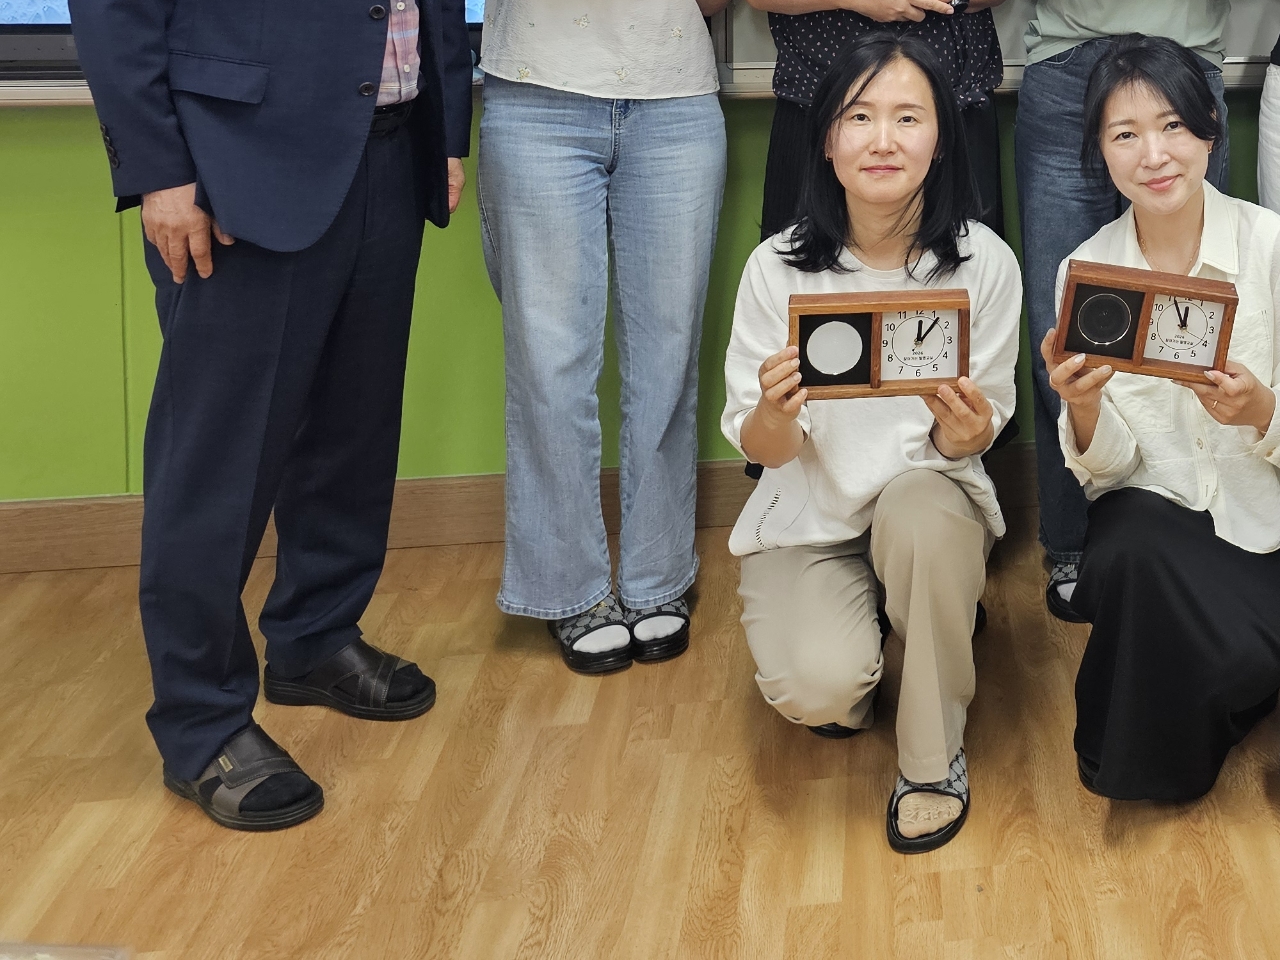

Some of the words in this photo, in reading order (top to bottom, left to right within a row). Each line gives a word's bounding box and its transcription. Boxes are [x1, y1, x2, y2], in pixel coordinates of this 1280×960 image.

[1154, 303, 1163, 311] 10
[897, 310, 907, 319] 11
[885, 323, 896, 331] 10
[944, 321, 950, 329] 2
[1209, 326, 1215, 334] 3
[882, 340, 888, 348] 9
[946, 336, 953, 344] 3
[1158, 346, 1164, 354] 7
[1190, 350, 1196, 358] 5
[887, 354, 894, 362] 8
[942, 351, 949, 359] 4
[898, 366, 904, 374] 7
[932, 364, 938, 372] 5
[915, 369, 921, 377] 6
